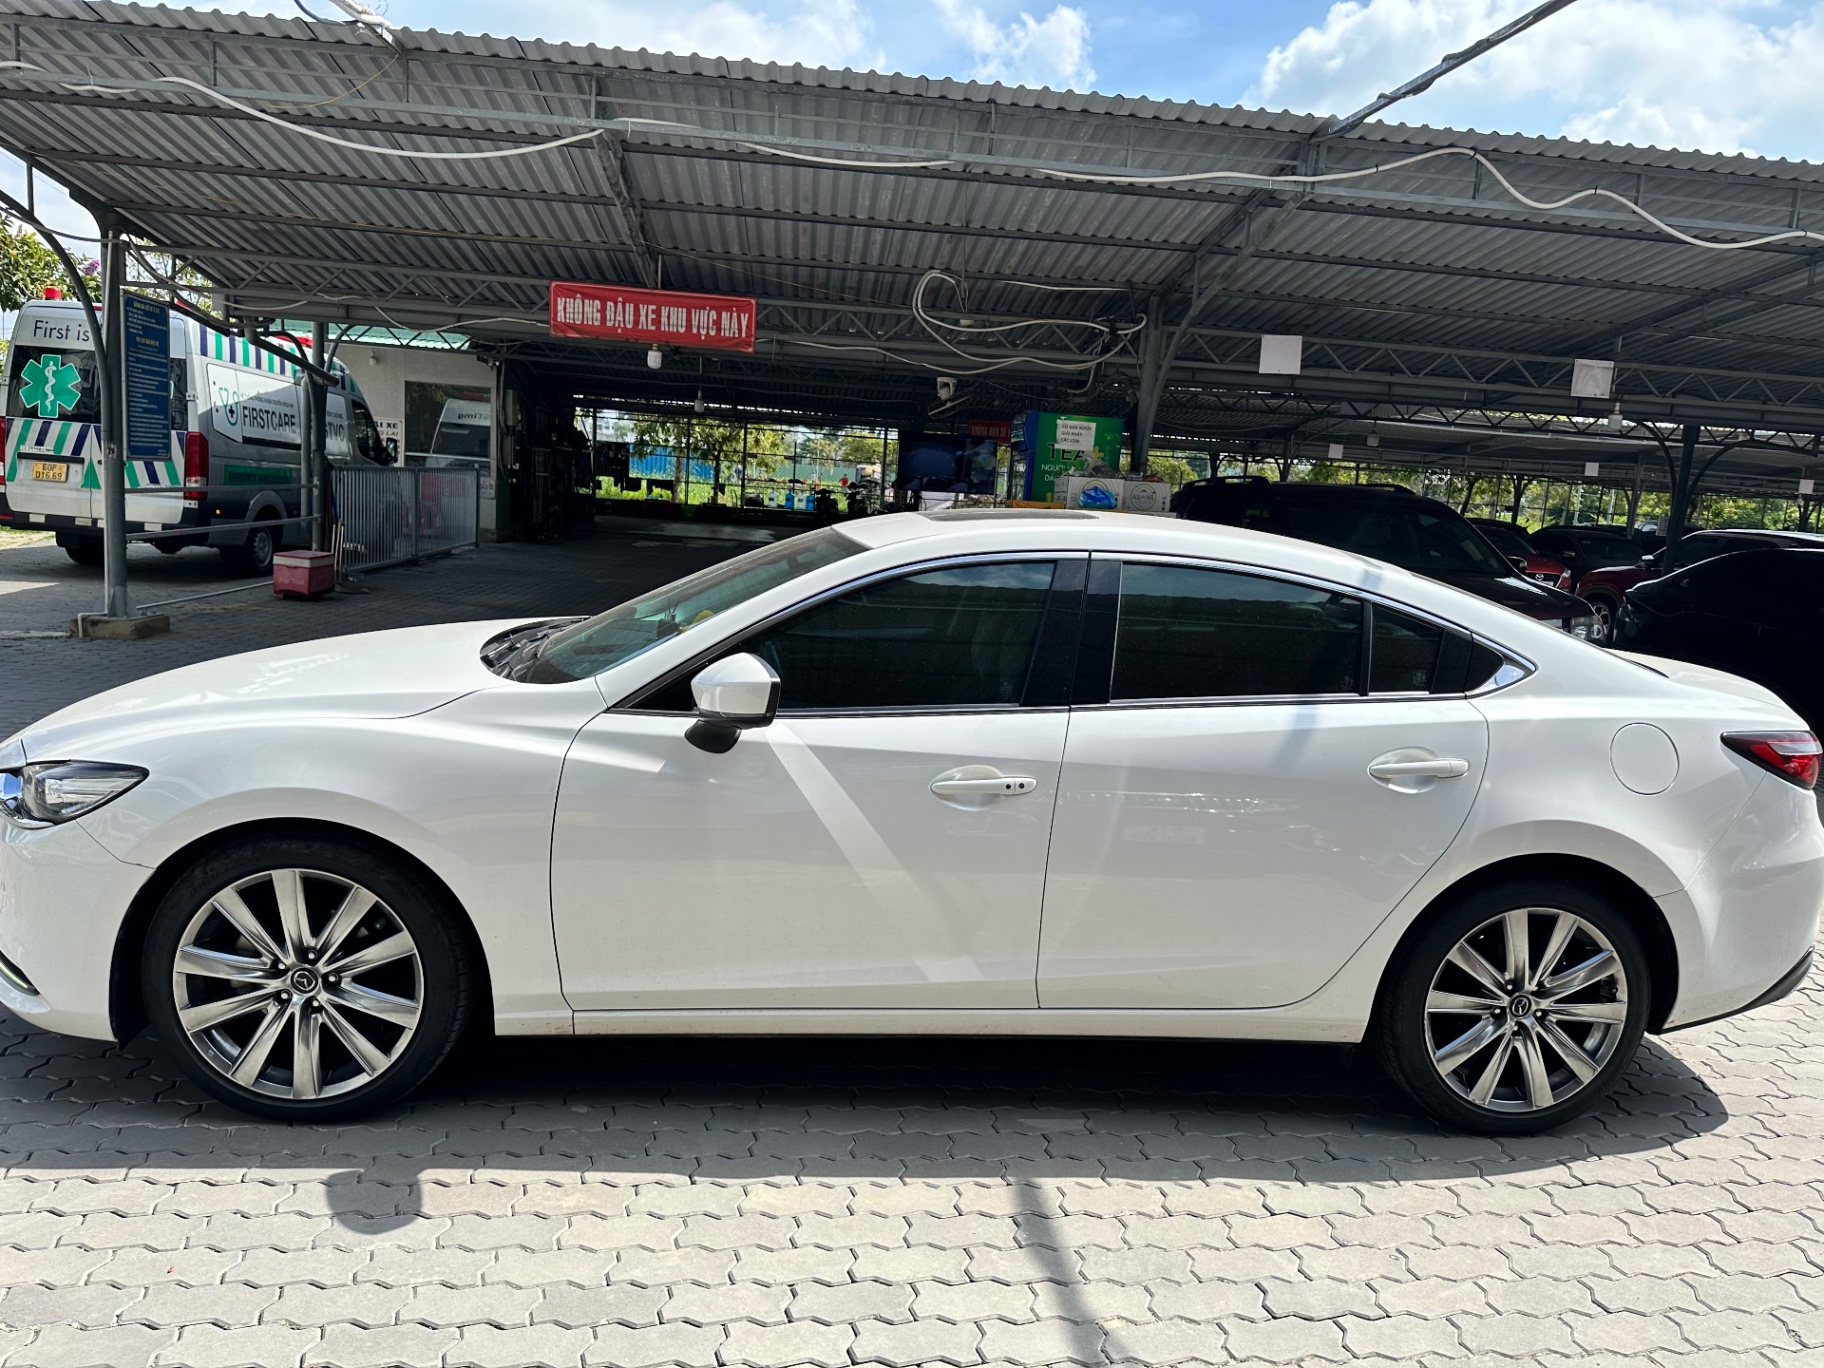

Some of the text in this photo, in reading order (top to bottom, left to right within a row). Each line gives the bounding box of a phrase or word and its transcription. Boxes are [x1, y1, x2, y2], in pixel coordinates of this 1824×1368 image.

[33, 320, 90, 341] First is
[557, 293, 749, 340] KHÔNG ĐẬU XE KHU VỰC NÀY
[242, 405, 296, 434] FIRSTCARE
